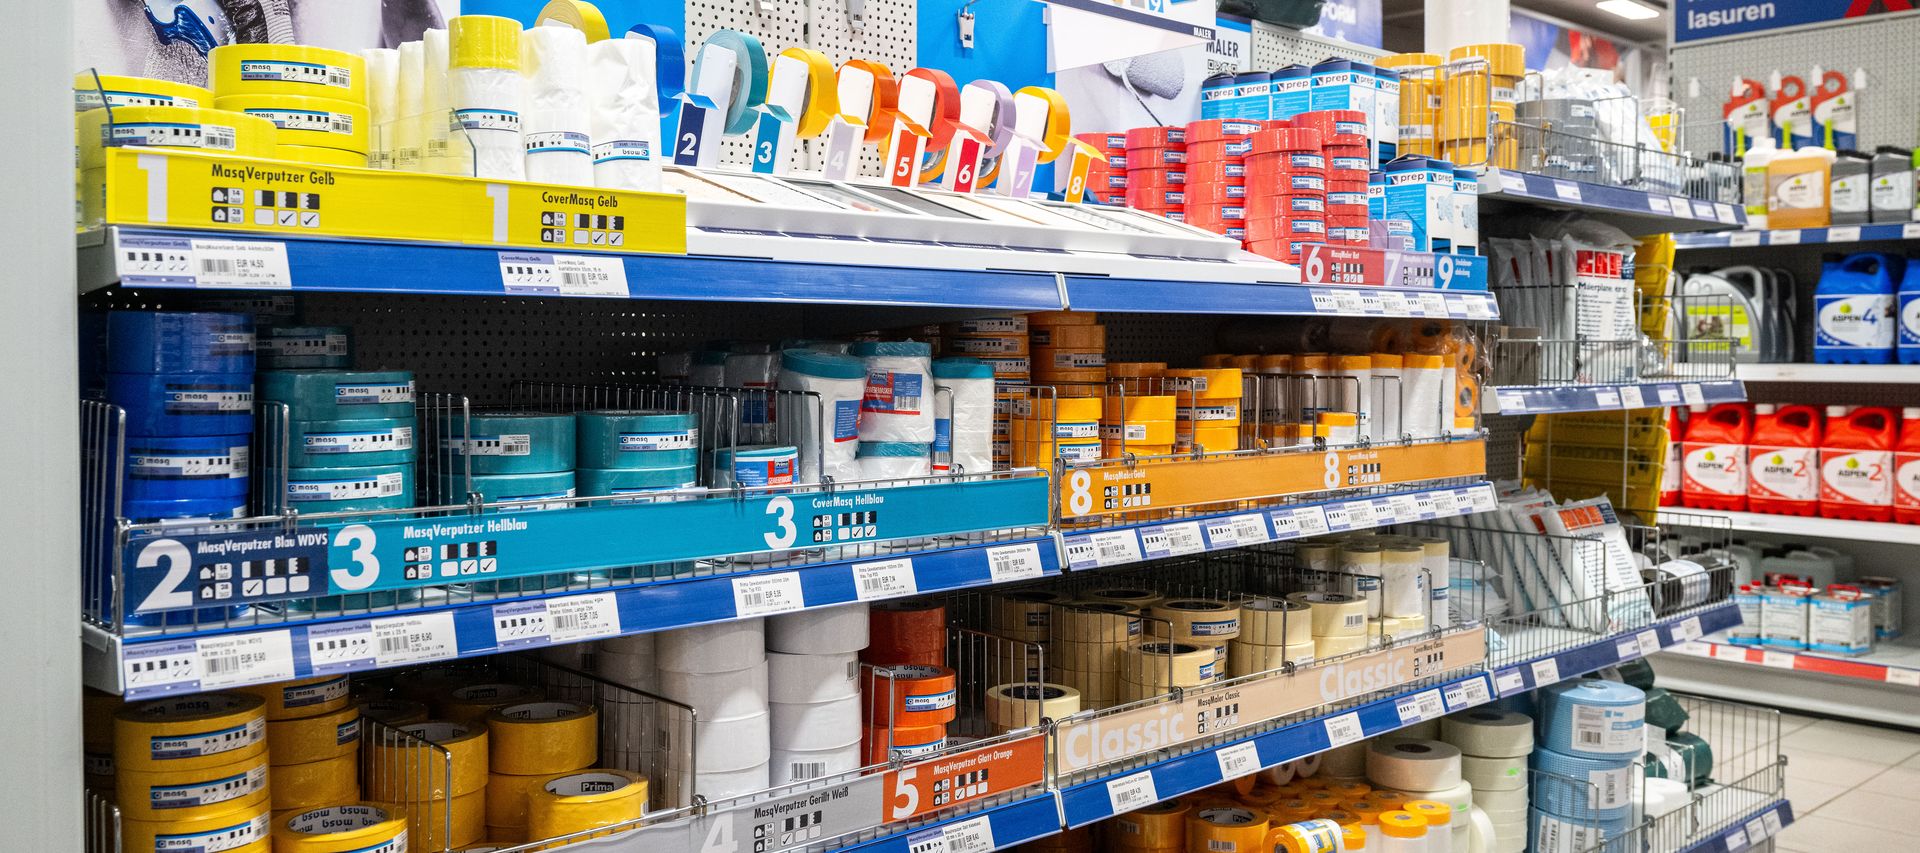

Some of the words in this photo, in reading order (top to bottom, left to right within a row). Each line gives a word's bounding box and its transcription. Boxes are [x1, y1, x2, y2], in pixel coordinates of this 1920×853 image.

[1688, 2, 1775, 30] lasuren
[1206, 39, 1239, 58] MALER
[1246, 84, 1268, 96] prep
[1286, 80, 1309, 92] prep
[1325, 74, 1349, 86] prep
[1213, 88, 1234, 100] prep
[679, 133, 697, 157] 2
[756, 141, 773, 164] 3
[829, 150, 845, 172] 4
[895, 156, 911, 178] 5
[211, 162, 305, 186] MasqVerputzer
[309, 171, 335, 186] Gelb
[957, 163, 972, 184] 6
[1015, 171, 1030, 189] 7
[1070, 175, 1083, 195] 8
[1400, 173, 1425, 185] prep
[136, 153, 169, 224] 1
[542, 191, 596, 210] CoverMasq
[597, 196, 619, 209] Gelb
[1369, 187, 1383, 196] ep
[485, 183, 509, 244] 1
[1305, 245, 1325, 284] 6
[1384, 252, 1402, 287] 7
[1437, 255, 1454, 290] 9
[1862, 307, 1878, 325] 4
[1323, 450, 1341, 491] 8
[1725, 455, 1737, 473] 2
[1793, 459, 1807, 478] 2
[1869, 463, 1883, 482] 2
[812, 496, 854, 511] CoverMasq
[854, 494, 885, 507] Hellblau
[1068, 469, 1093, 517] 8
[403, 521, 484, 542] MasqVerputzer
[486, 517, 528, 534] Hellblau
[763, 495, 798, 550] 3
[197, 540, 272, 557] MasqVerputzer
[274, 535, 297, 549] Blau
[297, 532, 329, 547] WDVS
[330, 523, 381, 592] 3
[135, 537, 194, 614] 2
[1319, 650, 1405, 704] Classic
[1064, 706, 1184, 768] Classic
[933, 756, 976, 776] MasqVerputzer
[977, 753, 993, 767] Glatt
[993, 747, 1013, 763] Orange
[582, 782, 614, 794] Prima
[892, 766, 920, 821] 5
[754, 798, 807, 821] MasqVerputzer
[807, 793, 830, 807] Gerillt
[831, 785, 850, 799] Weiß
[699, 811, 740, 853] 4
